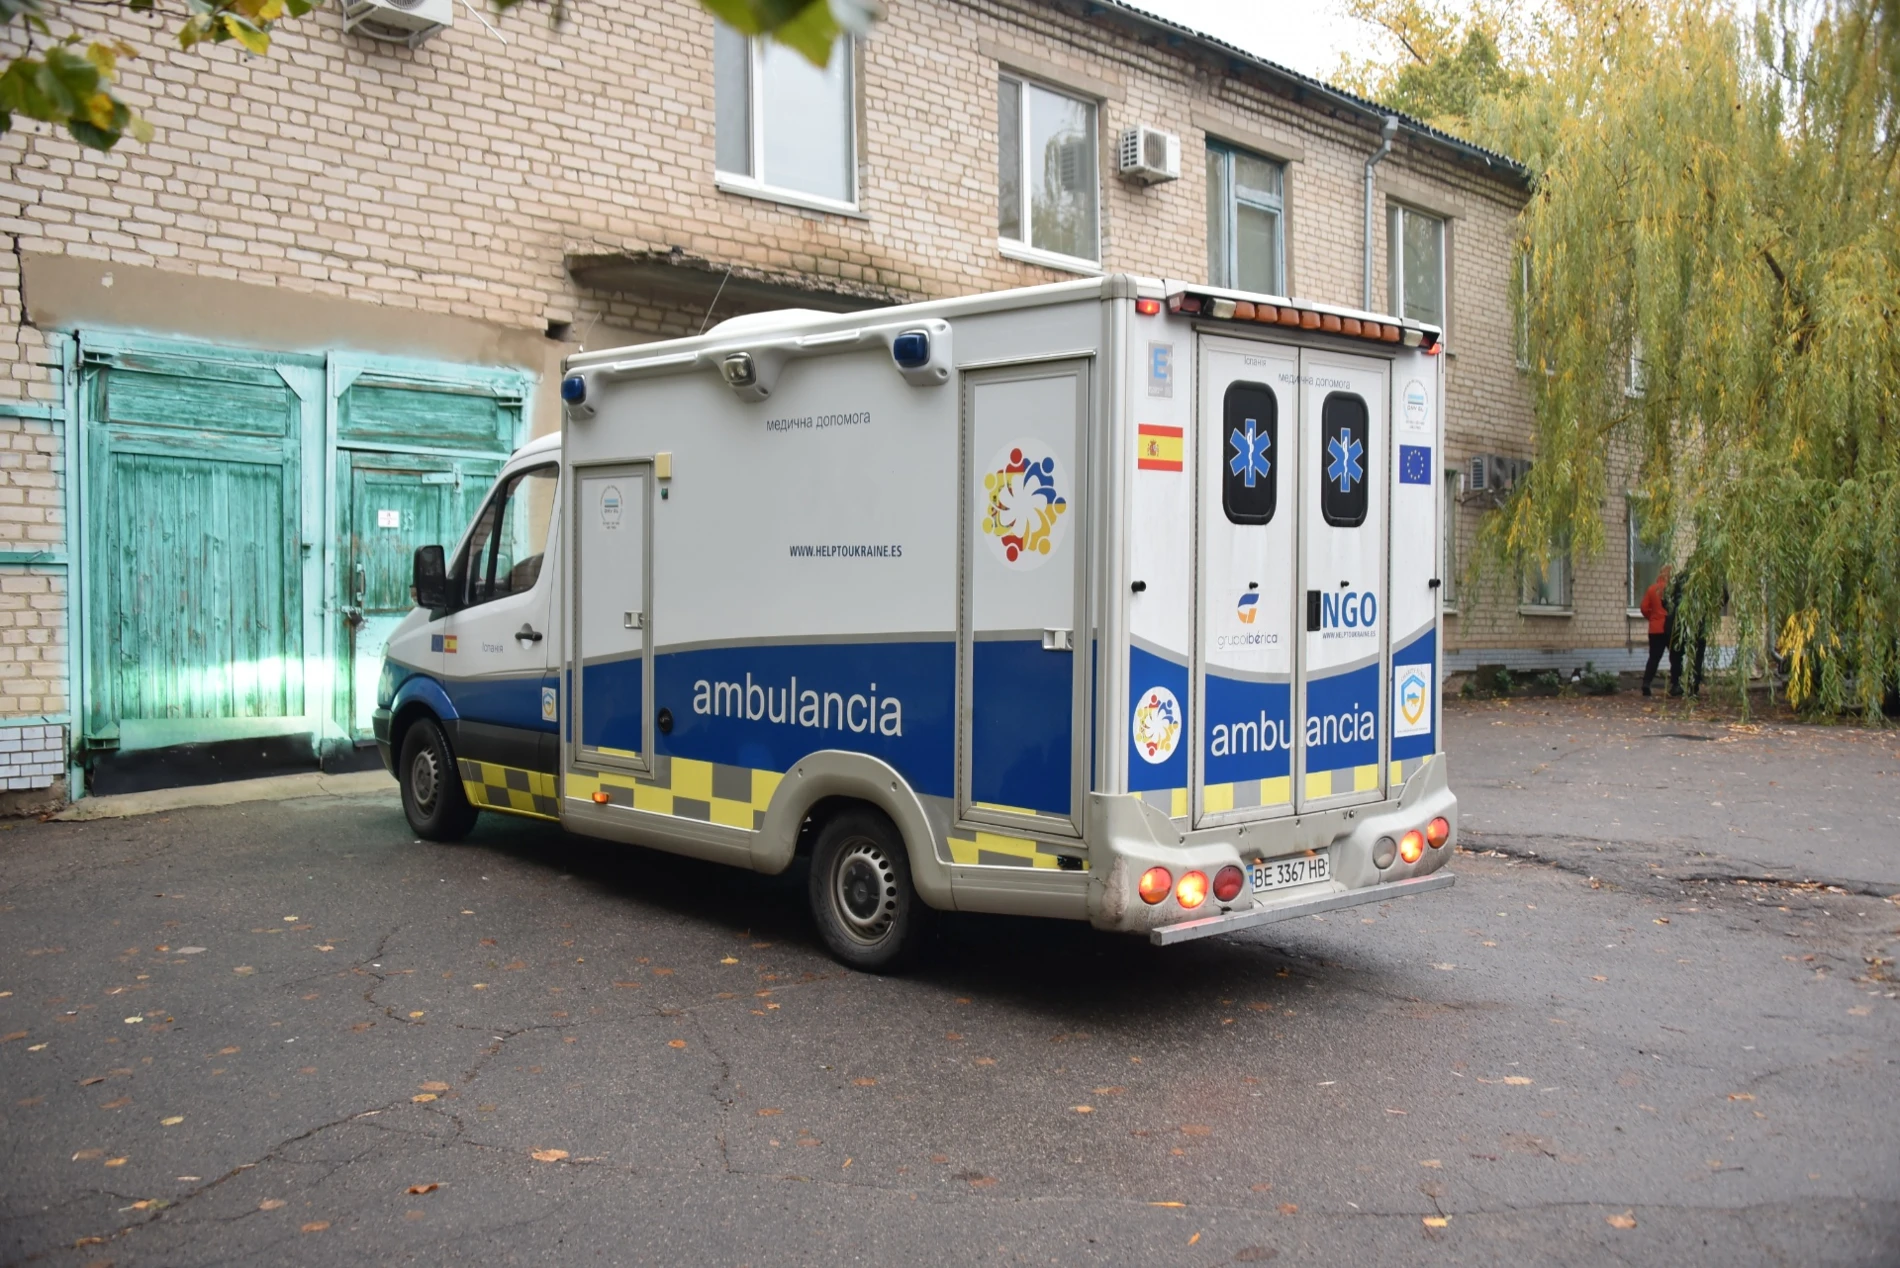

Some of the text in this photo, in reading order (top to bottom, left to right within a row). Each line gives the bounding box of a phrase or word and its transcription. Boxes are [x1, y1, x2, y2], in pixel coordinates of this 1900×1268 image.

[1315, 377, 1351, 389] допомога
[766, 411, 871, 432] медична допомога
[789, 545, 902, 557] WWW.HELPTOUKRAINE.ES
[1322, 591, 1377, 628] NGO
[1322, 631, 1376, 639] WWW.HELPTOUKRAINE.ES
[693, 672, 902, 737] ambulancia
[1211, 702, 1374, 757] ambulancia
[1255, 858, 1326, 888] BE 3367 HB
